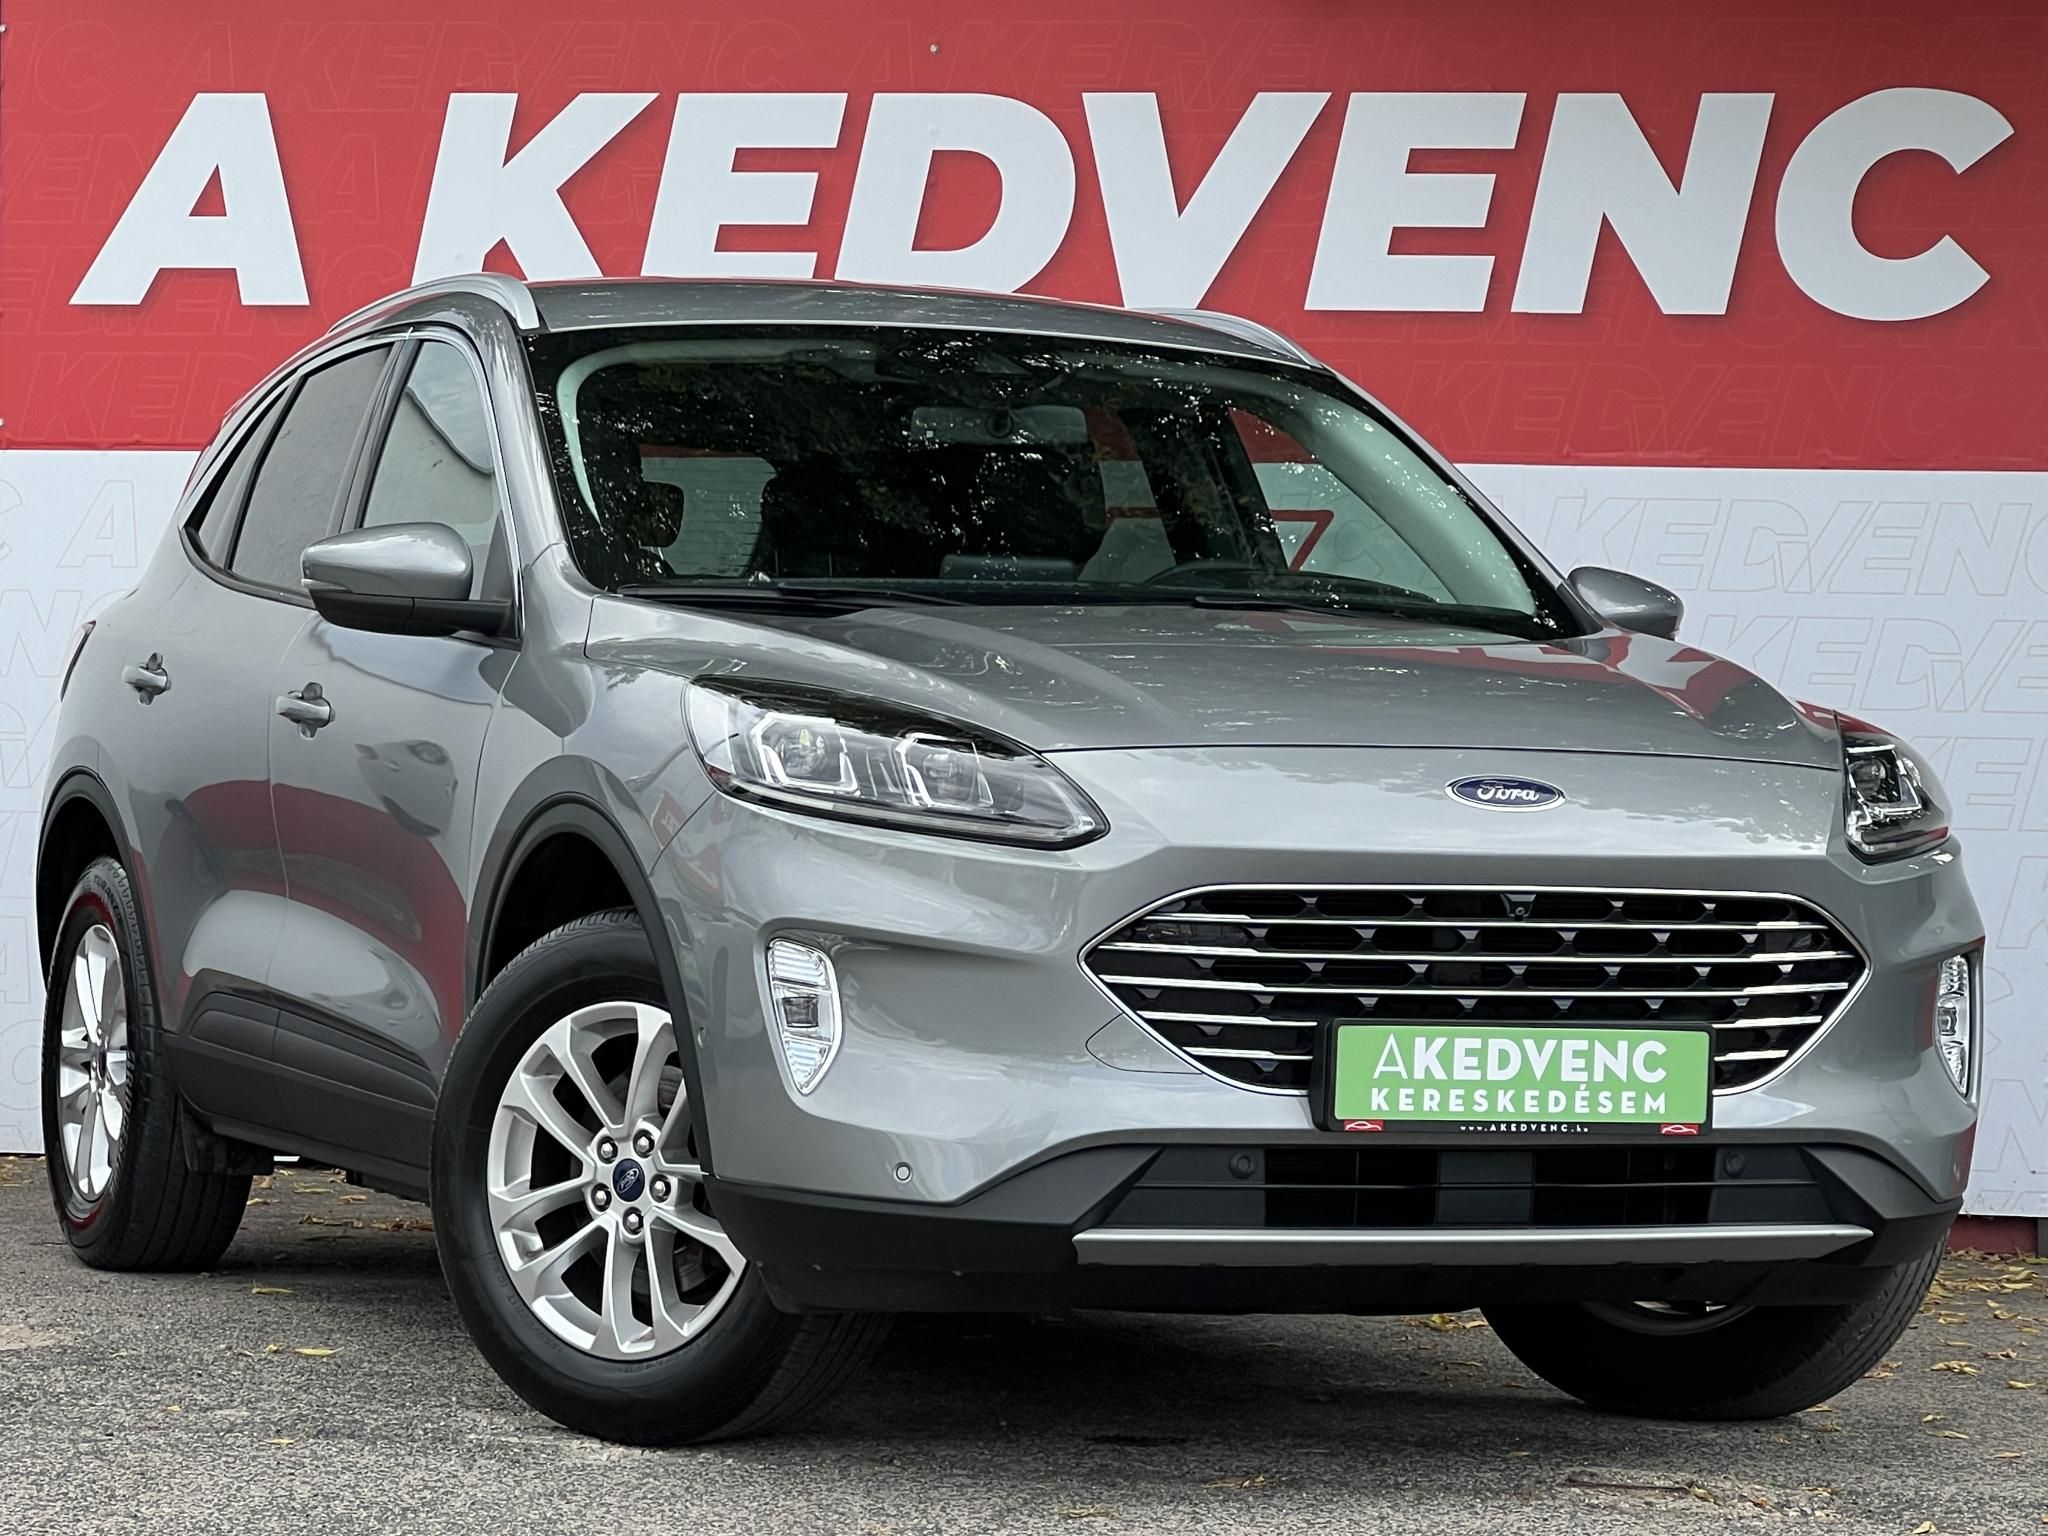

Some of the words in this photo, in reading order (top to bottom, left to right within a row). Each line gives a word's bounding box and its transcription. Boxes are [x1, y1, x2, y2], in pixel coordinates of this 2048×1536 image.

[70, 91, 310, 305] A
[411, 87, 2014, 322] KEDVENC
[1544, 495, 2048, 596] KEDVEN
[1371, 1084, 1666, 1115] KERESKEDÉSEM
